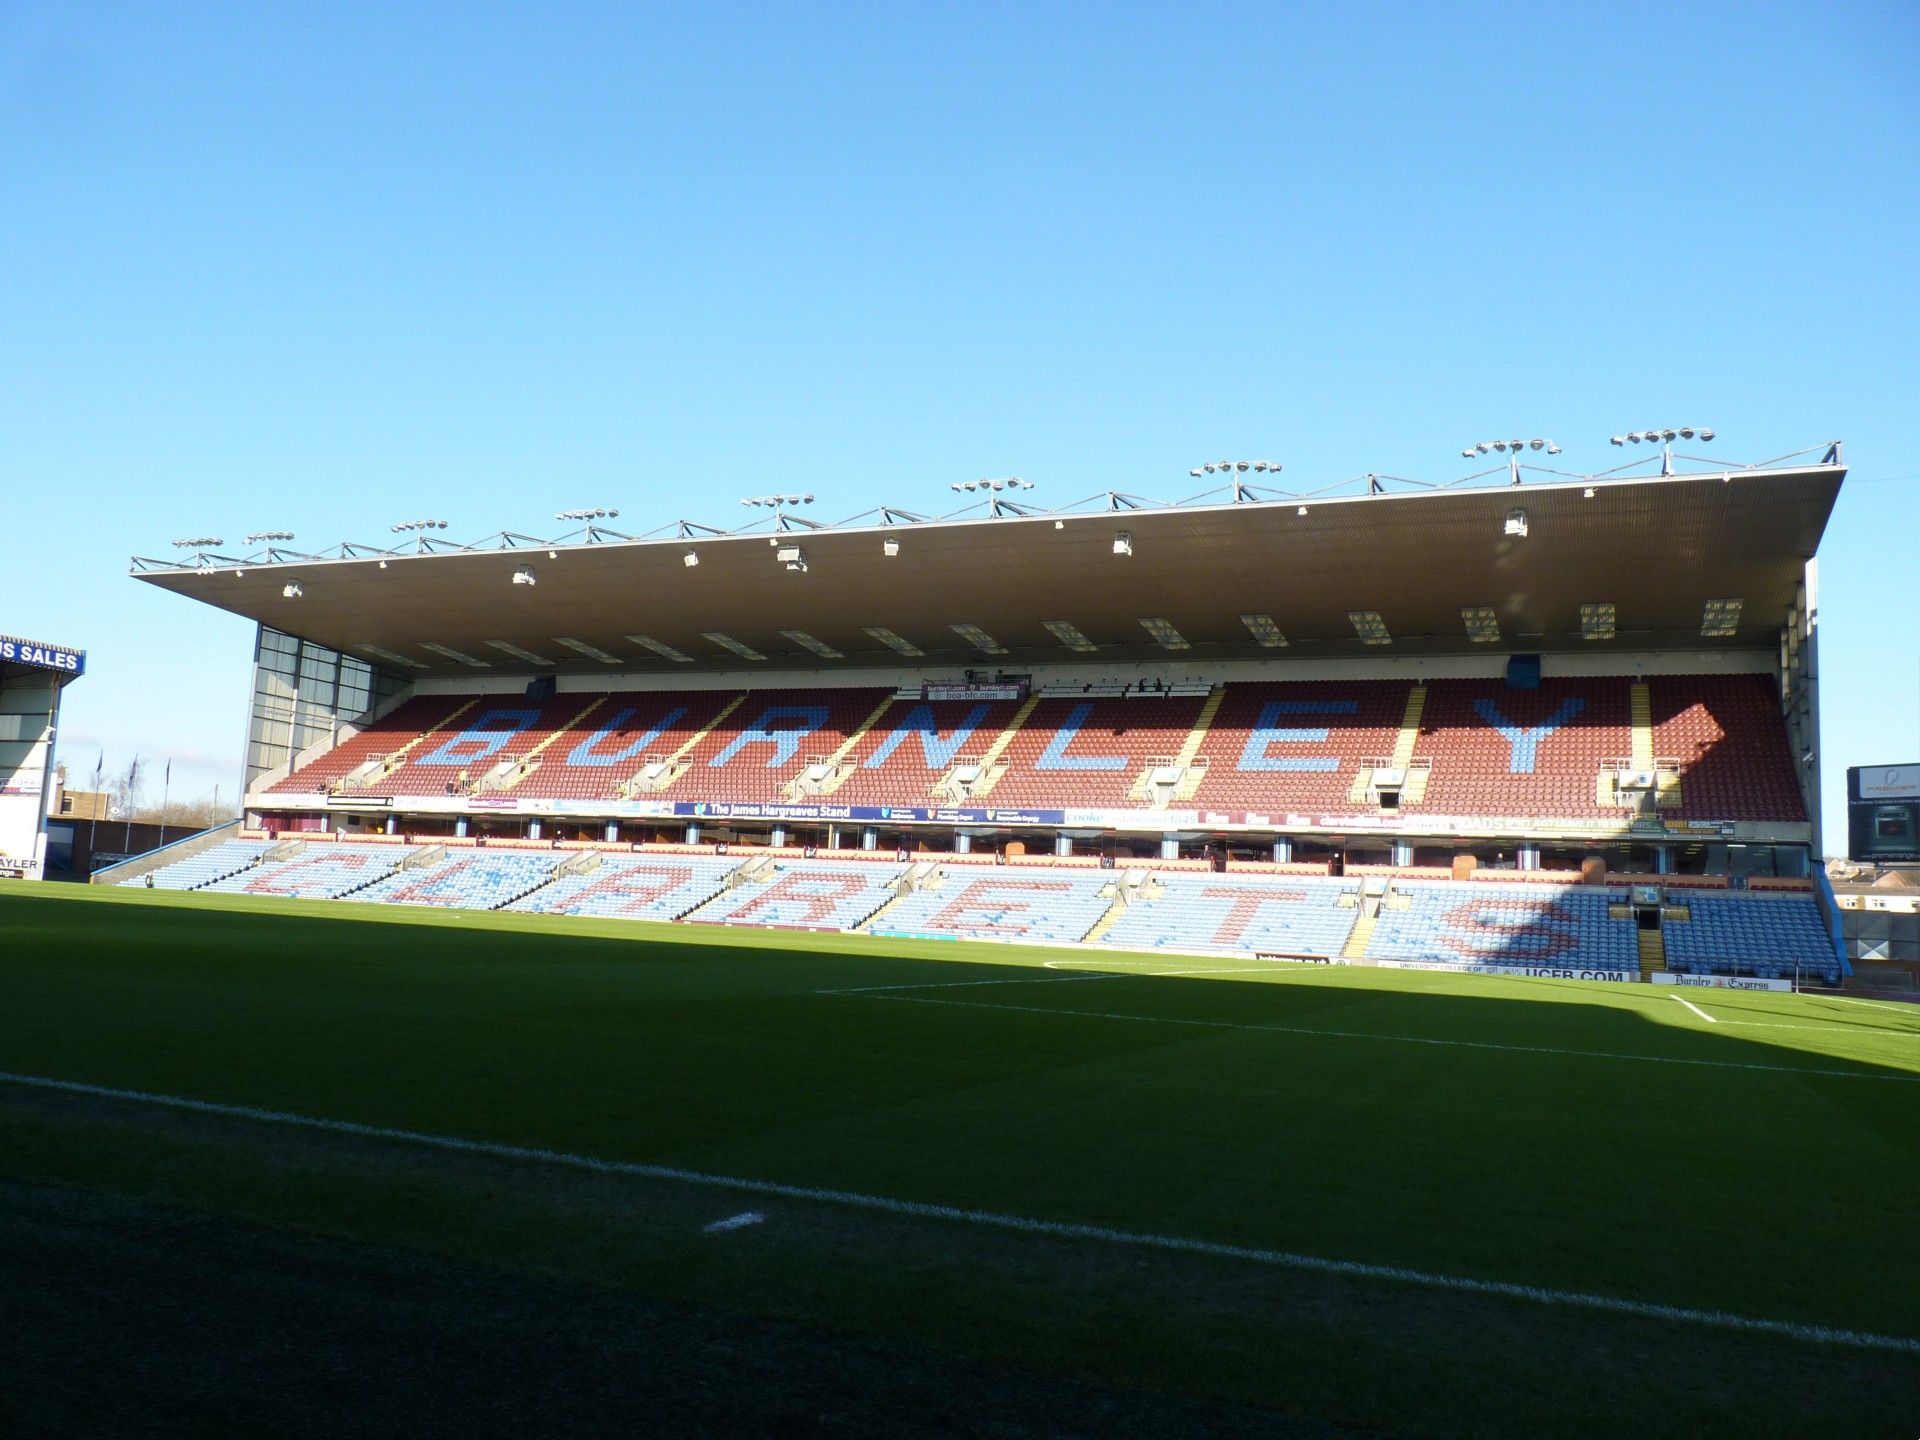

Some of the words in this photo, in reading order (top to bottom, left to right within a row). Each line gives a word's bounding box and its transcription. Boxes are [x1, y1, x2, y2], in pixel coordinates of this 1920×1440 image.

[0, 641, 15, 658] S
[20, 646, 77, 670] SALES
[946, 691, 998, 700] boa-bfc.com
[414, 698, 1586, 775] BURNLEY
[710, 804, 729, 814] The
[731, 804, 760, 817] James
[761, 804, 818, 818] Hargreaves
[820, 805, 850, 817] Stand
[1066, 812, 1105, 823] cooke
[1169, 814, 1196, 825] 1845
[244, 853, 1580, 961] CLARETS
[1674, 974, 1712, 987] Burnley
[1727, 977, 1769, 990] Express
